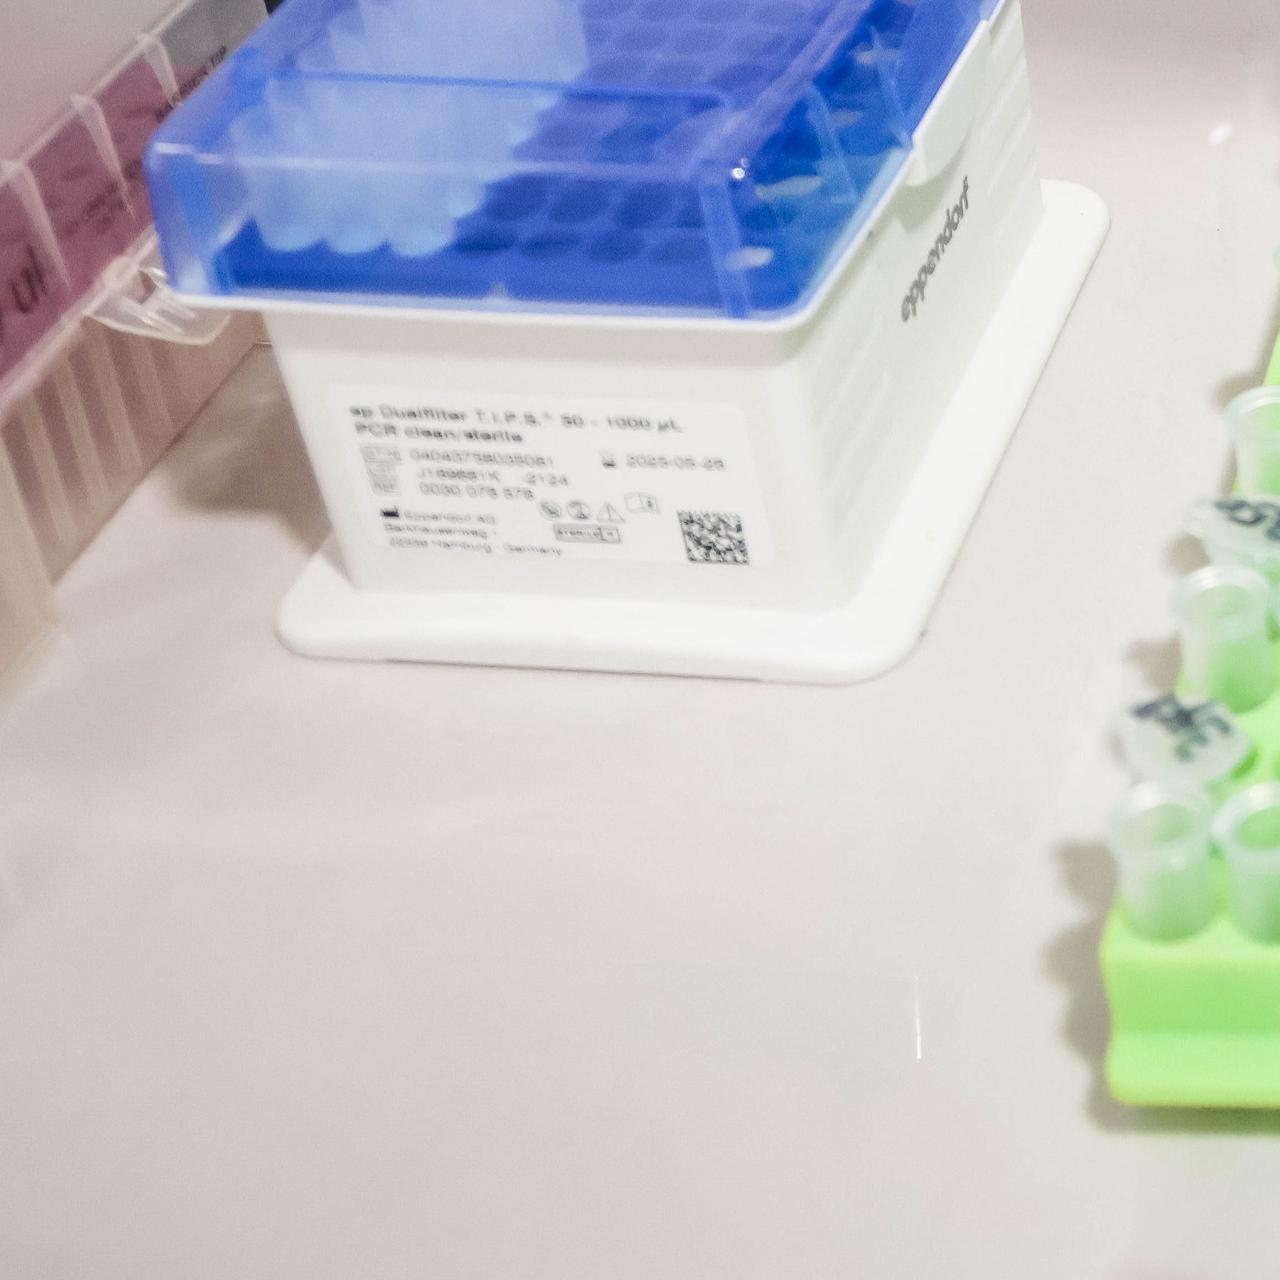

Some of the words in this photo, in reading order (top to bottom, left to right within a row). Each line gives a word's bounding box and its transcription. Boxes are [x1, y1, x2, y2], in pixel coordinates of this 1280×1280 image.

[901, 176, 969, 323] eppendorf
[354, 421, 397, 438] PCR
[605, 415, 651, 432] 1000
